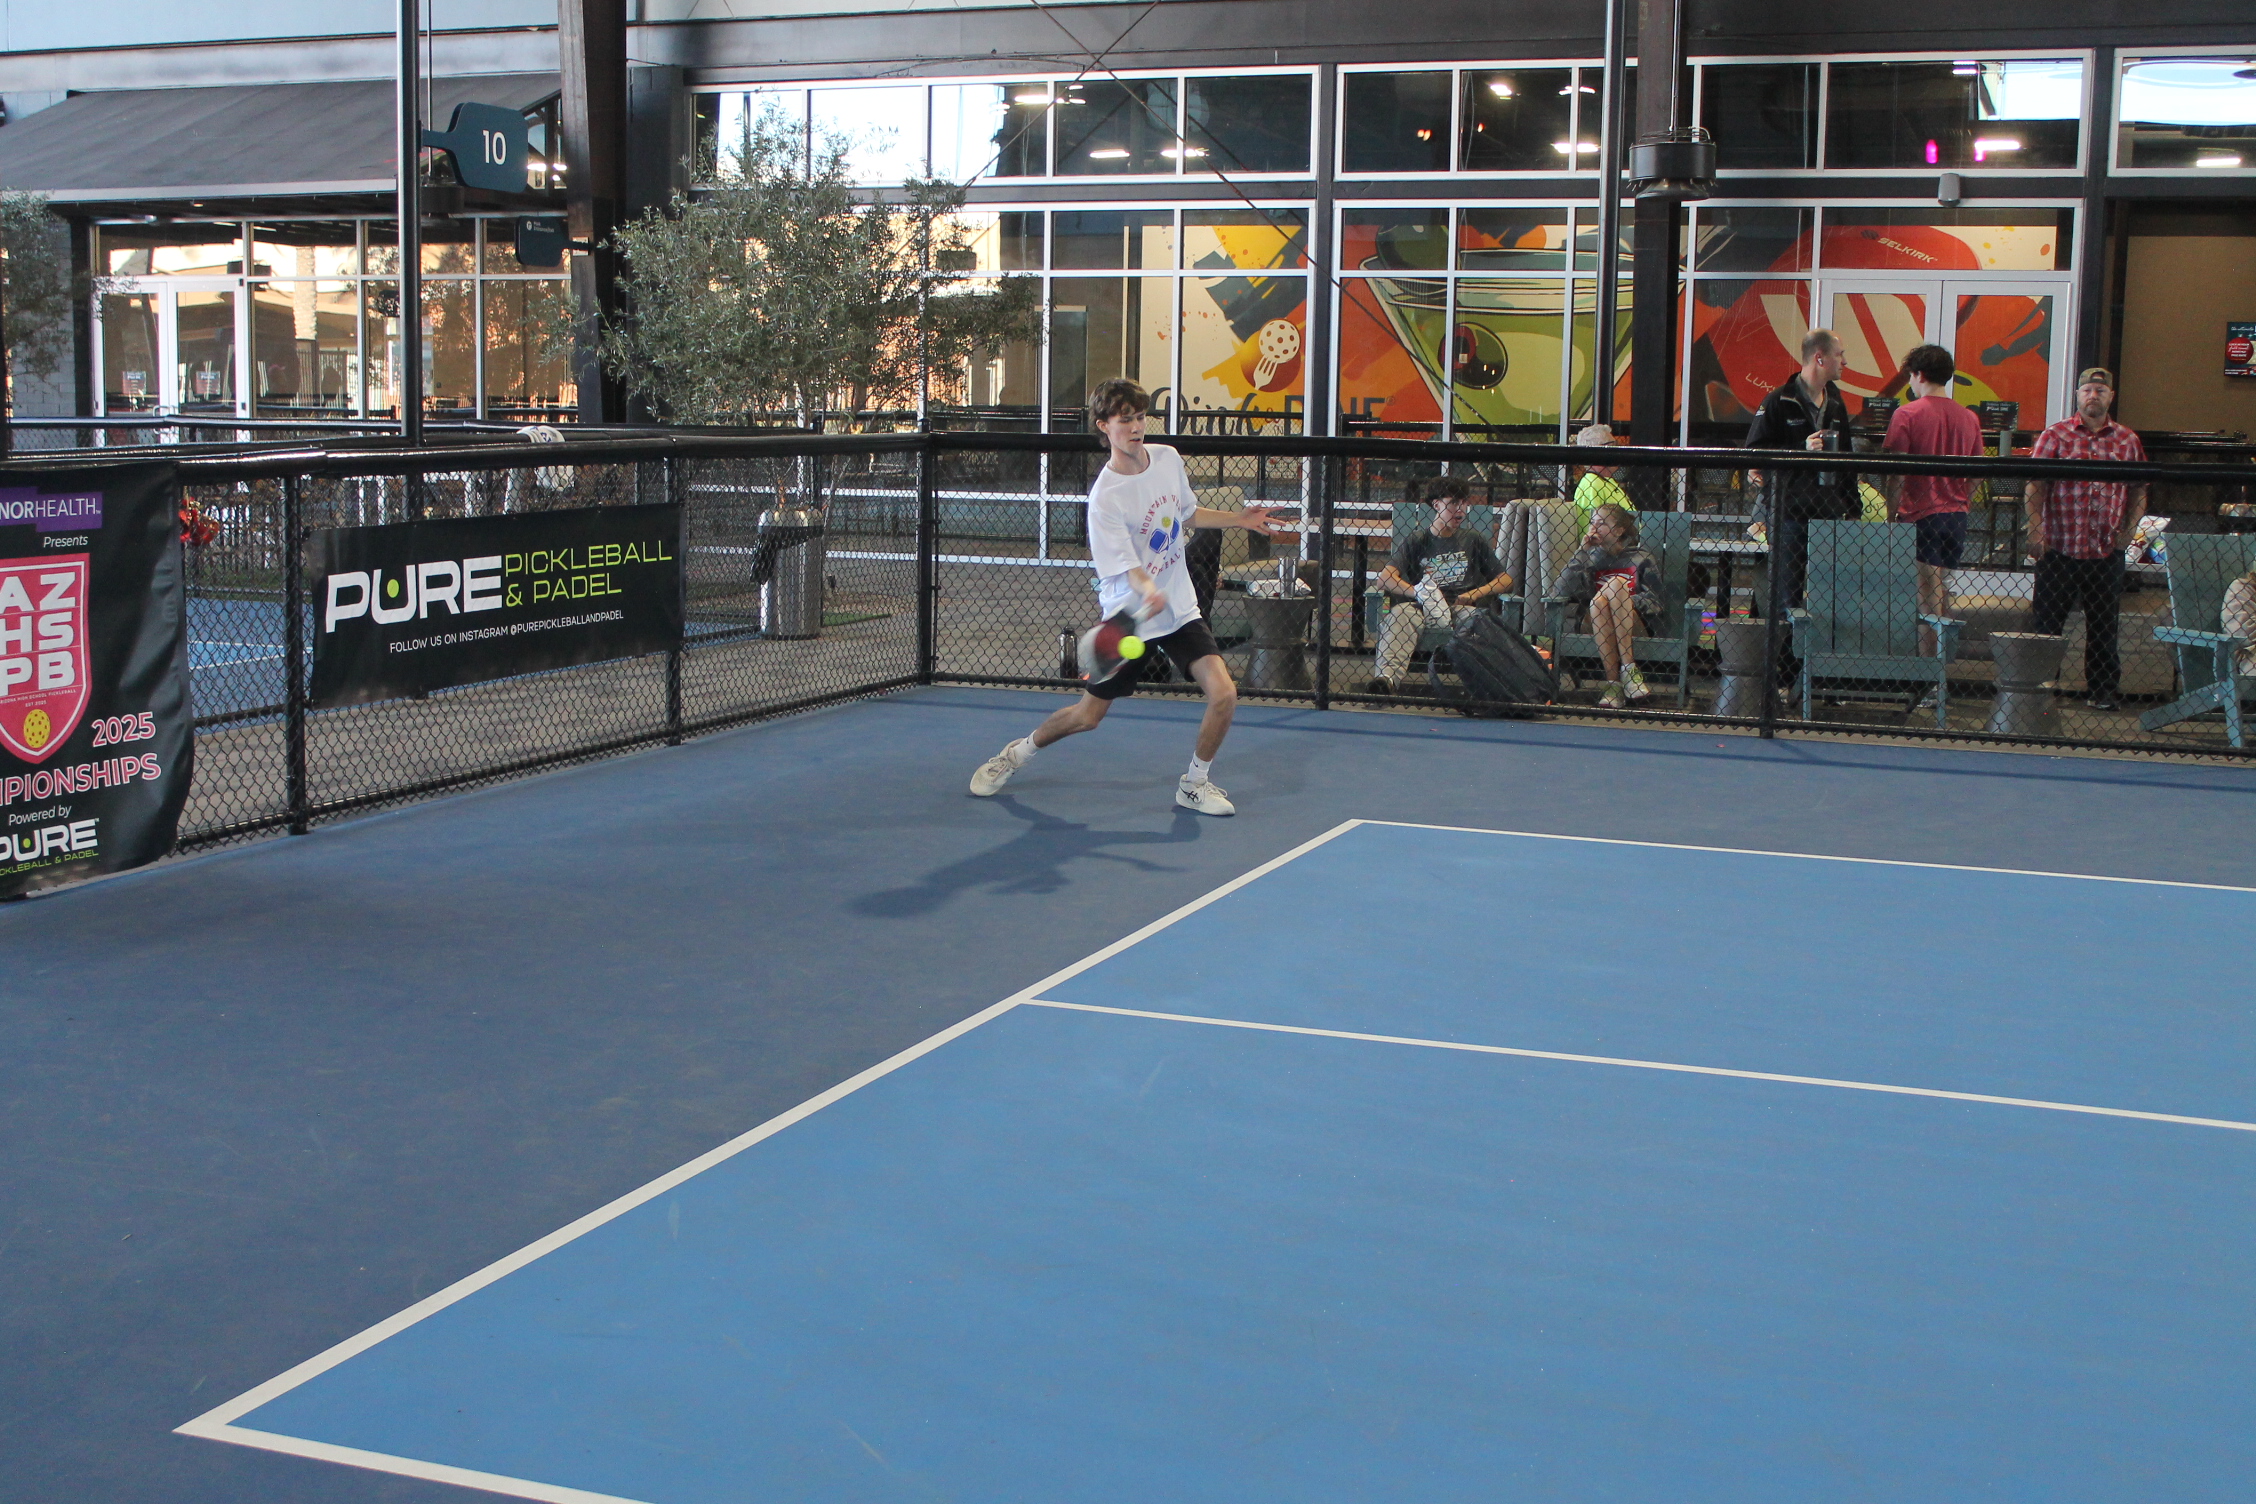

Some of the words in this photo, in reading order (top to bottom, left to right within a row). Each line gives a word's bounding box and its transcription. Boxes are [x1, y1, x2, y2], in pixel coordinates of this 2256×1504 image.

[482, 129, 507, 165] 10
[1877, 237, 1934, 263] SELKIRK
[1745, 373, 1776, 394] LUX
[43, 535, 89, 548] Presents
[505, 540, 673, 577] PICKLEBALL
[0, 571, 76, 614] AZ
[325, 555, 503, 633] PURE
[505, 583, 523, 608] &
[533, 573, 623, 603] PADEL
[0, 611, 74, 656] HS
[389, 637, 428, 653] FOLLOW
[430, 635, 442, 647] US
[444, 633, 457, 645] ON
[459, 625, 509, 642] INSTAGRAM
[510, 610, 624, 635] @PUREPICKLEBALLANDPADEL
[0, 650, 76, 697] PB
[91, 711, 156, 747] 2025
[0, 752, 162, 806] PIONSHIPS
[8, 806, 56, 826] Powered
[58, 804, 72, 818] by
[55, 856, 62, 864] &
[64, 849, 99, 862] PADEL
